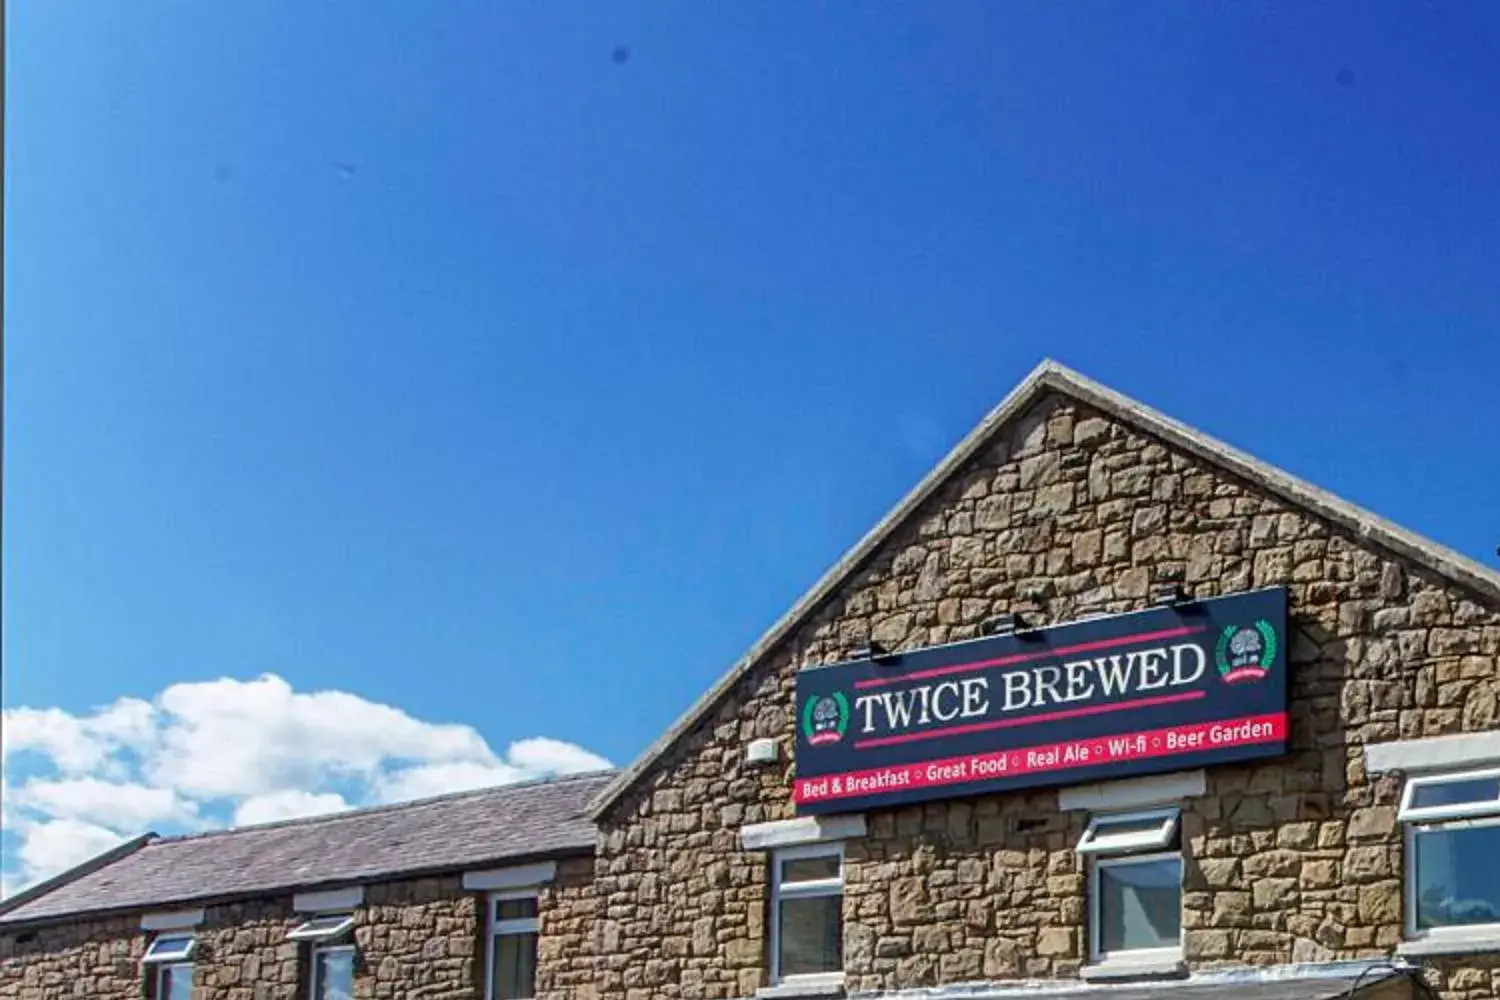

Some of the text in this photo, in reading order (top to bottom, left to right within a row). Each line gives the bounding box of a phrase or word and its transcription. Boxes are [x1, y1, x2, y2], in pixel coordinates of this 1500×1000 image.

[855, 643, 1206, 733] TWICE BREWED
[803, 720, 1273, 798] Bed & Breakfast Great Food Real Ale Wi-fi Beer Garden
